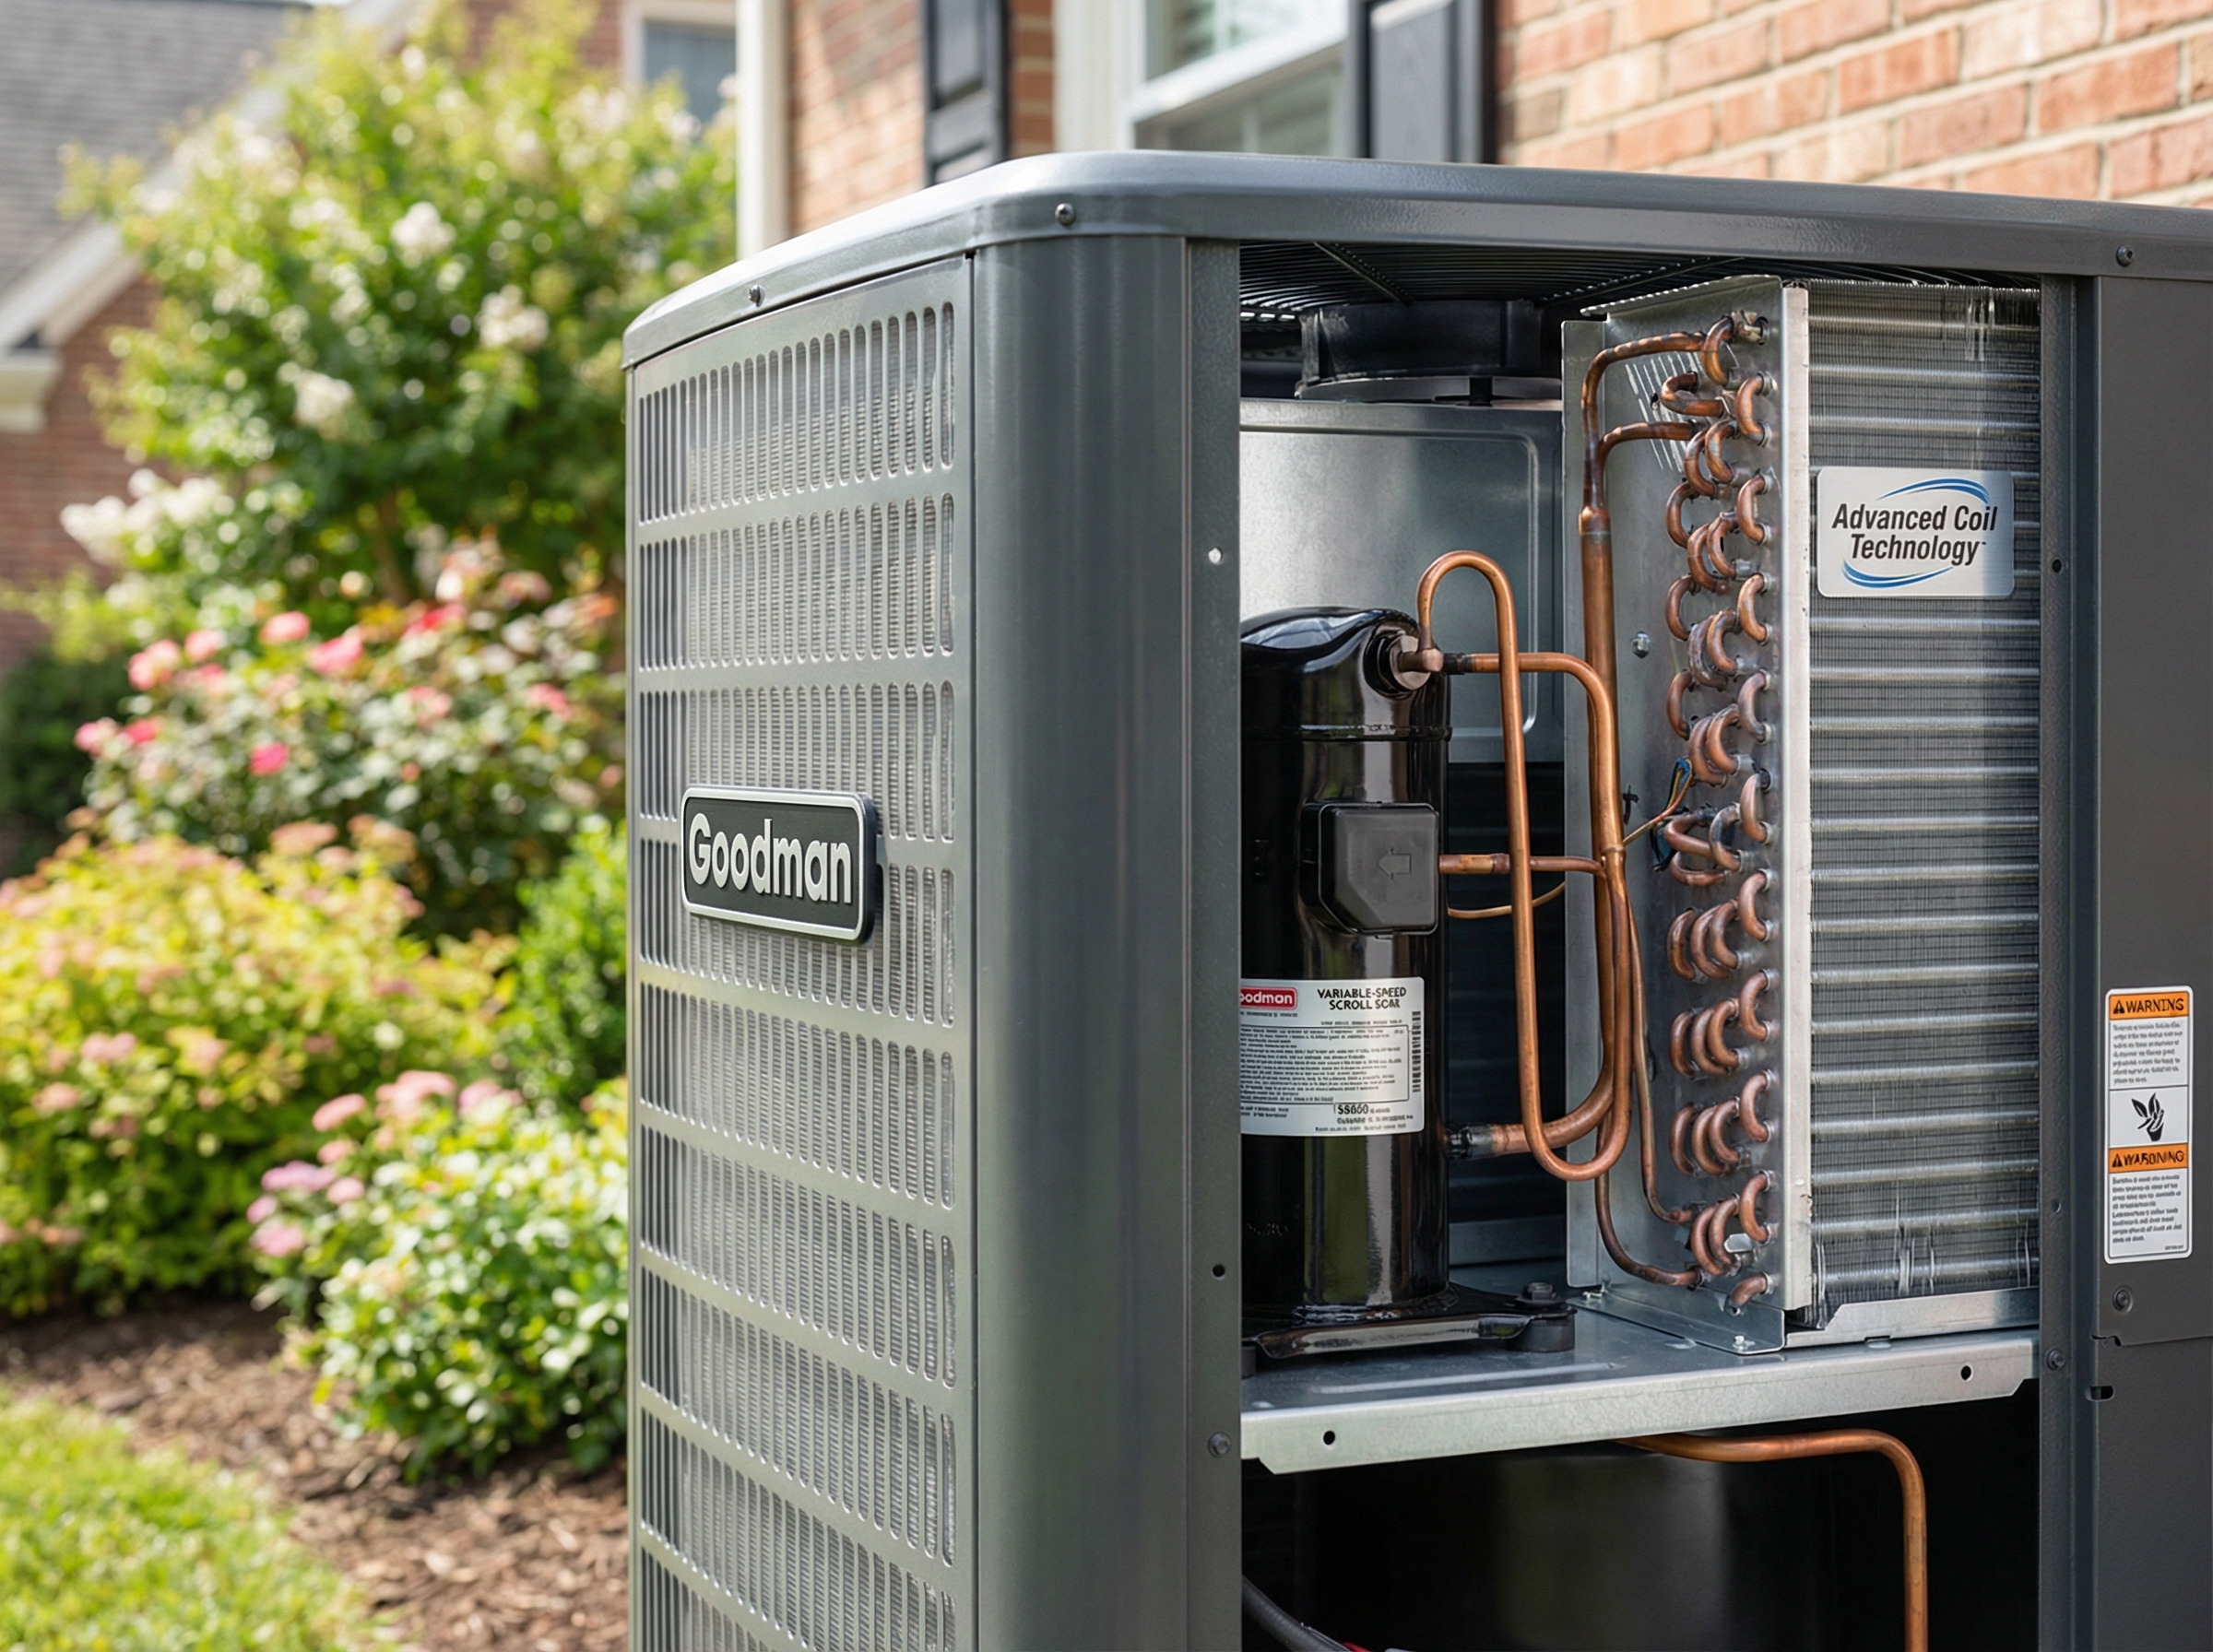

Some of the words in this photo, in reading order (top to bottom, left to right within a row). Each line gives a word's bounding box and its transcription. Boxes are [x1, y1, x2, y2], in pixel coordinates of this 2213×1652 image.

[1831, 503, 1947, 530] Advanced
[1954, 505, 1998, 531] Coil
[1851, 534, 1980, 566] Technology
[689, 812, 851, 904] Goodman
[1329, 999, 1372, 1010] SCROLL
